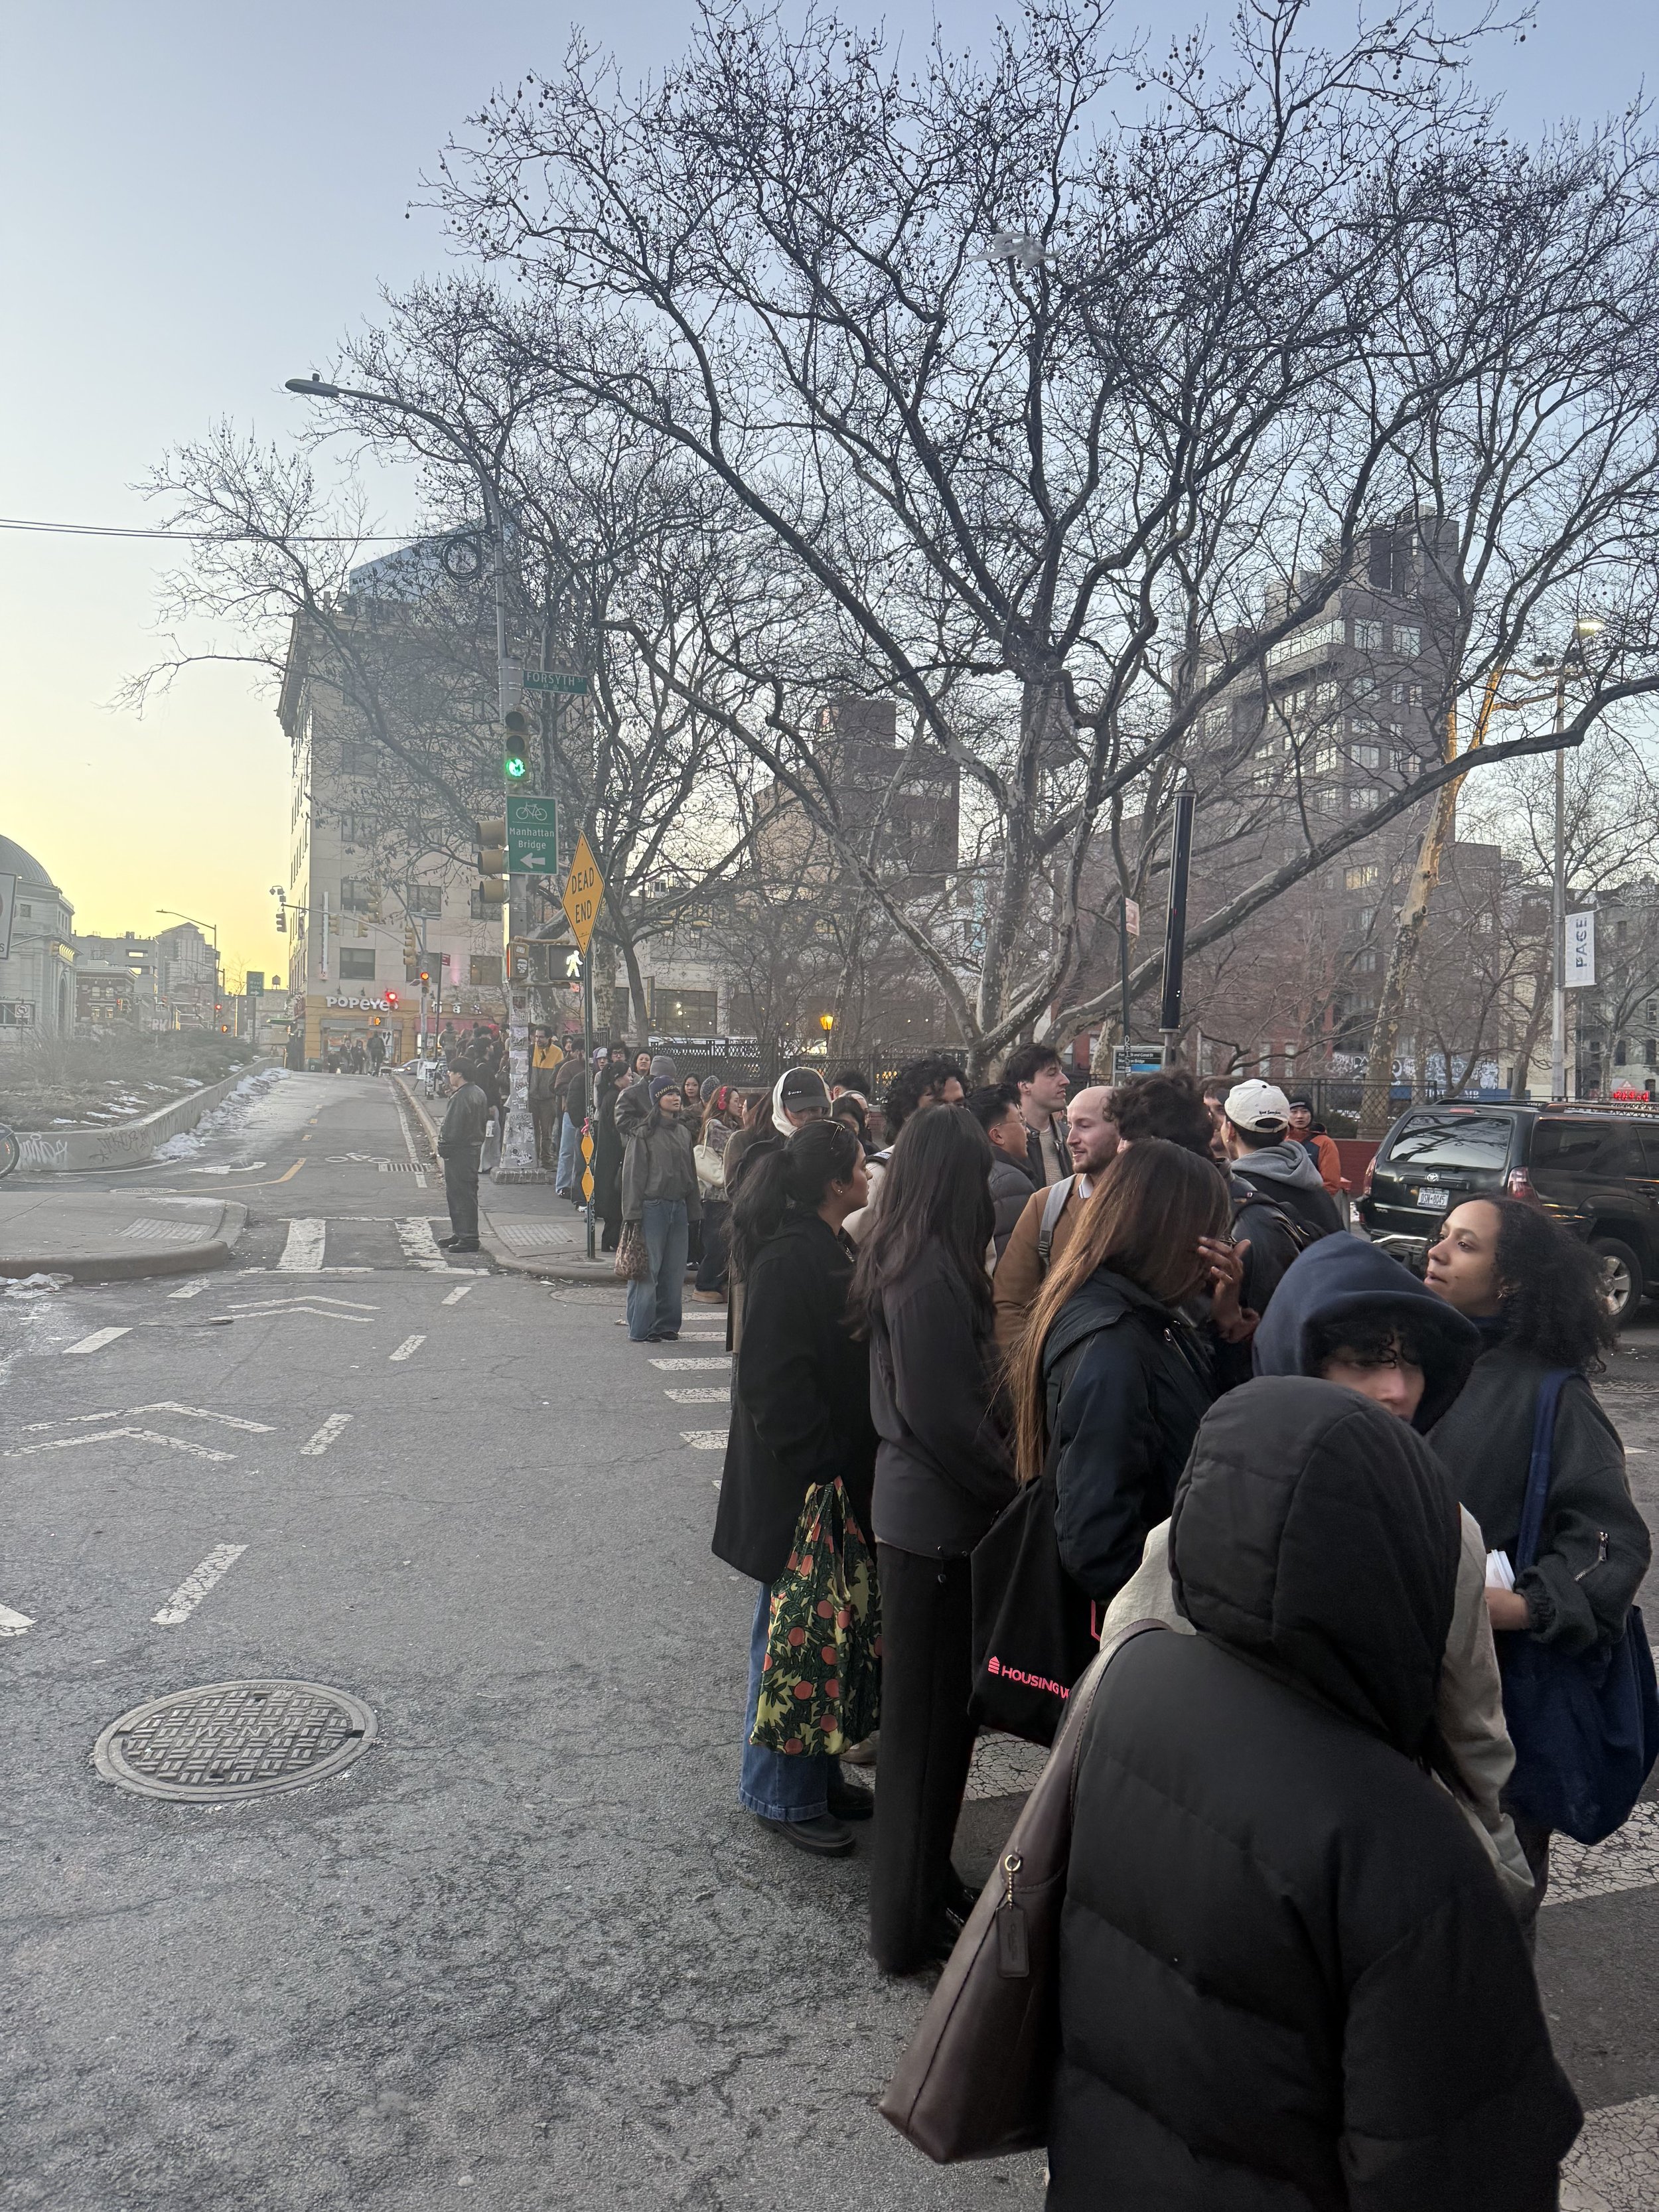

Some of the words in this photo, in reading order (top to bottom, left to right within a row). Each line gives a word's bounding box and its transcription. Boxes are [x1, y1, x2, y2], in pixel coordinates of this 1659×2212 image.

[527, 672, 575, 686] FORSYTH
[509, 828, 554, 838] Manhattan
[518, 840, 546, 850] Bridge
[571, 867, 595, 895] DEAD
[575, 900, 592, 924] END
[1001, 1665, 1059, 1694] HOUSING
